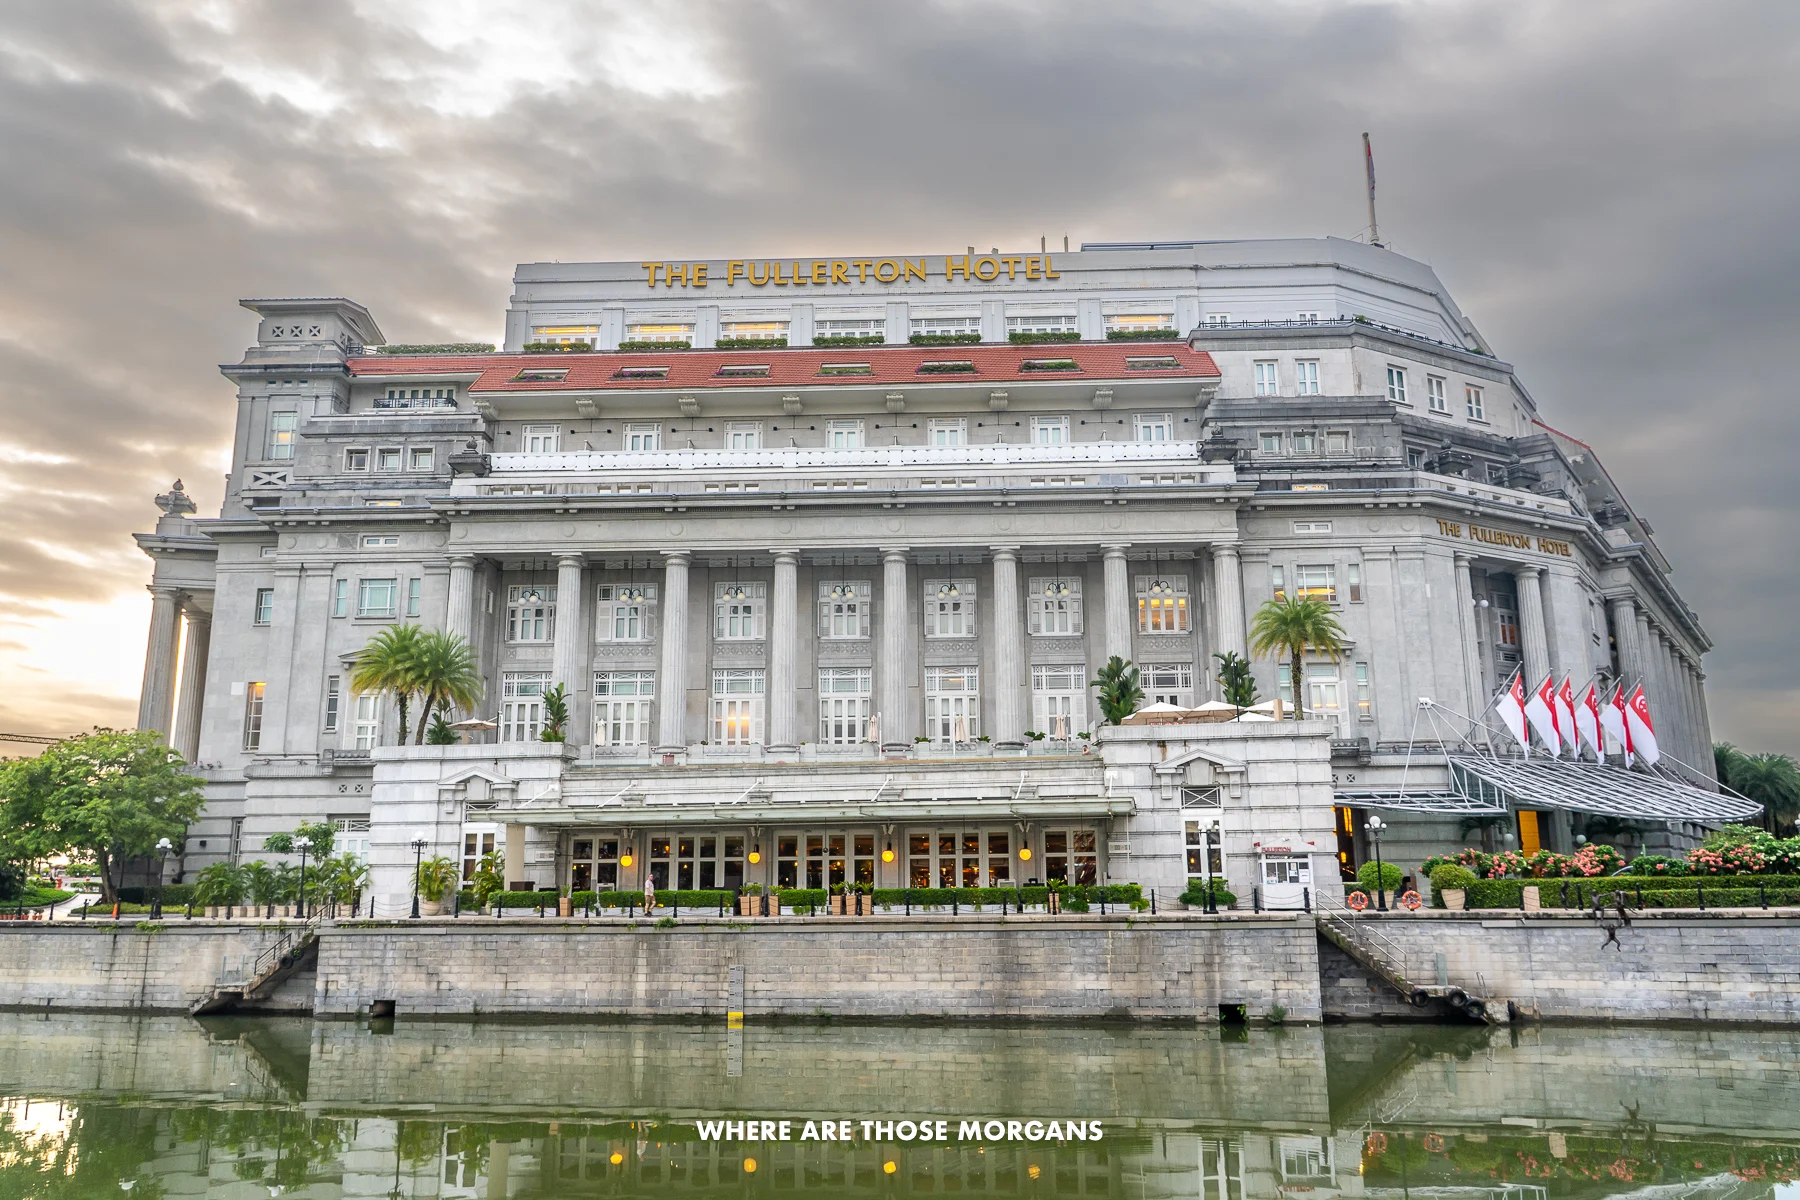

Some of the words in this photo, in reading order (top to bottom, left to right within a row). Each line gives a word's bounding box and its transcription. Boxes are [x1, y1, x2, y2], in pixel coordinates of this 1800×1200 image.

[642, 262, 708, 287] THE
[727, 258, 926, 287] FULLERTON
[946, 255, 1061, 281] HOTEL
[1437, 519, 1461, 537] THE
[1469, 524, 1531, 549] FULLERTON
[1537, 537, 1572, 556] HOTEL
